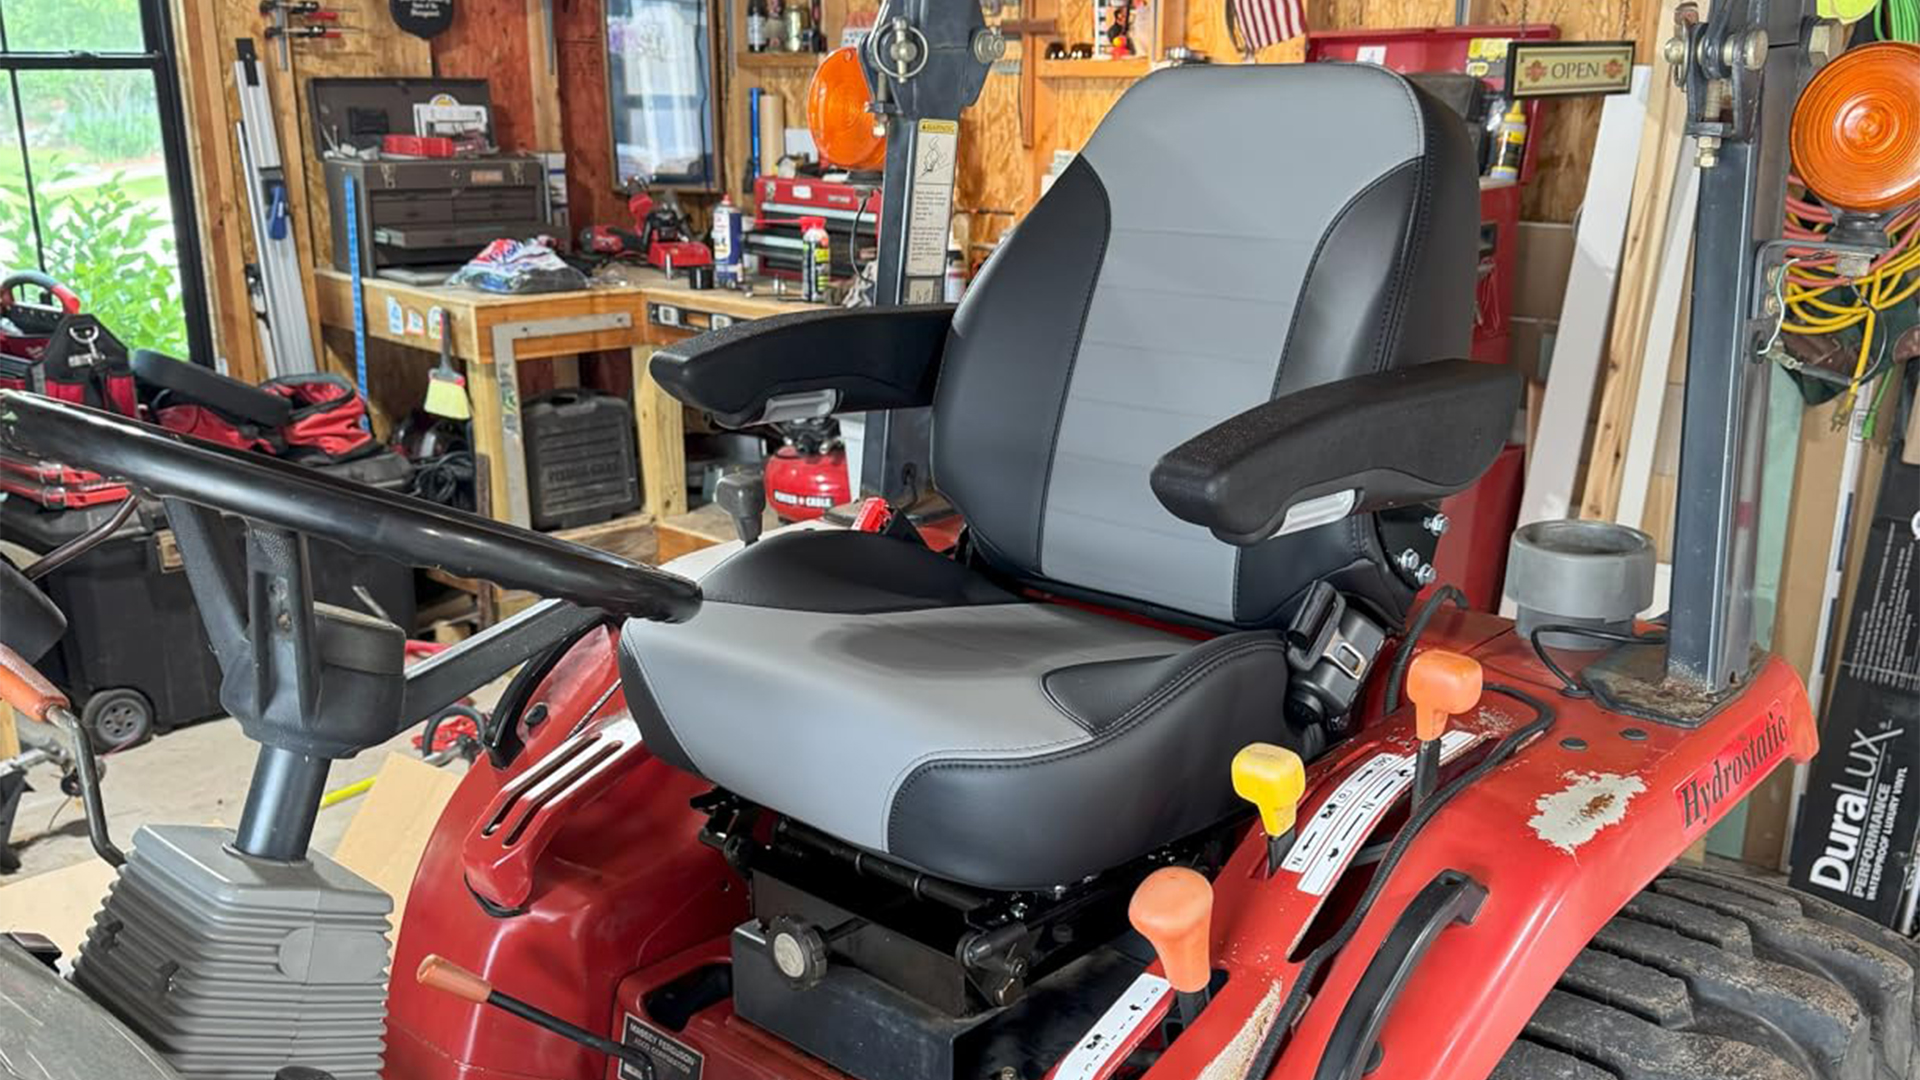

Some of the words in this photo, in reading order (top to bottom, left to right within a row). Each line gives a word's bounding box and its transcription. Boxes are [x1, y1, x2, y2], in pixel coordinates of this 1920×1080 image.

[1551, 62, 1600, 79] OPEN
[1681, 711, 1788, 829] Hydrostatic
[1853, 782, 1891, 898] PERFORMANCE
[1866, 837, 1890, 900] WATERPROOF
[1883, 794, 1899, 835] LUXURY
[1894, 767, 1908, 796] VINYL
[629, 1022, 659, 1043] MASSEY
[658, 1039, 695, 1066] FERGUSON
